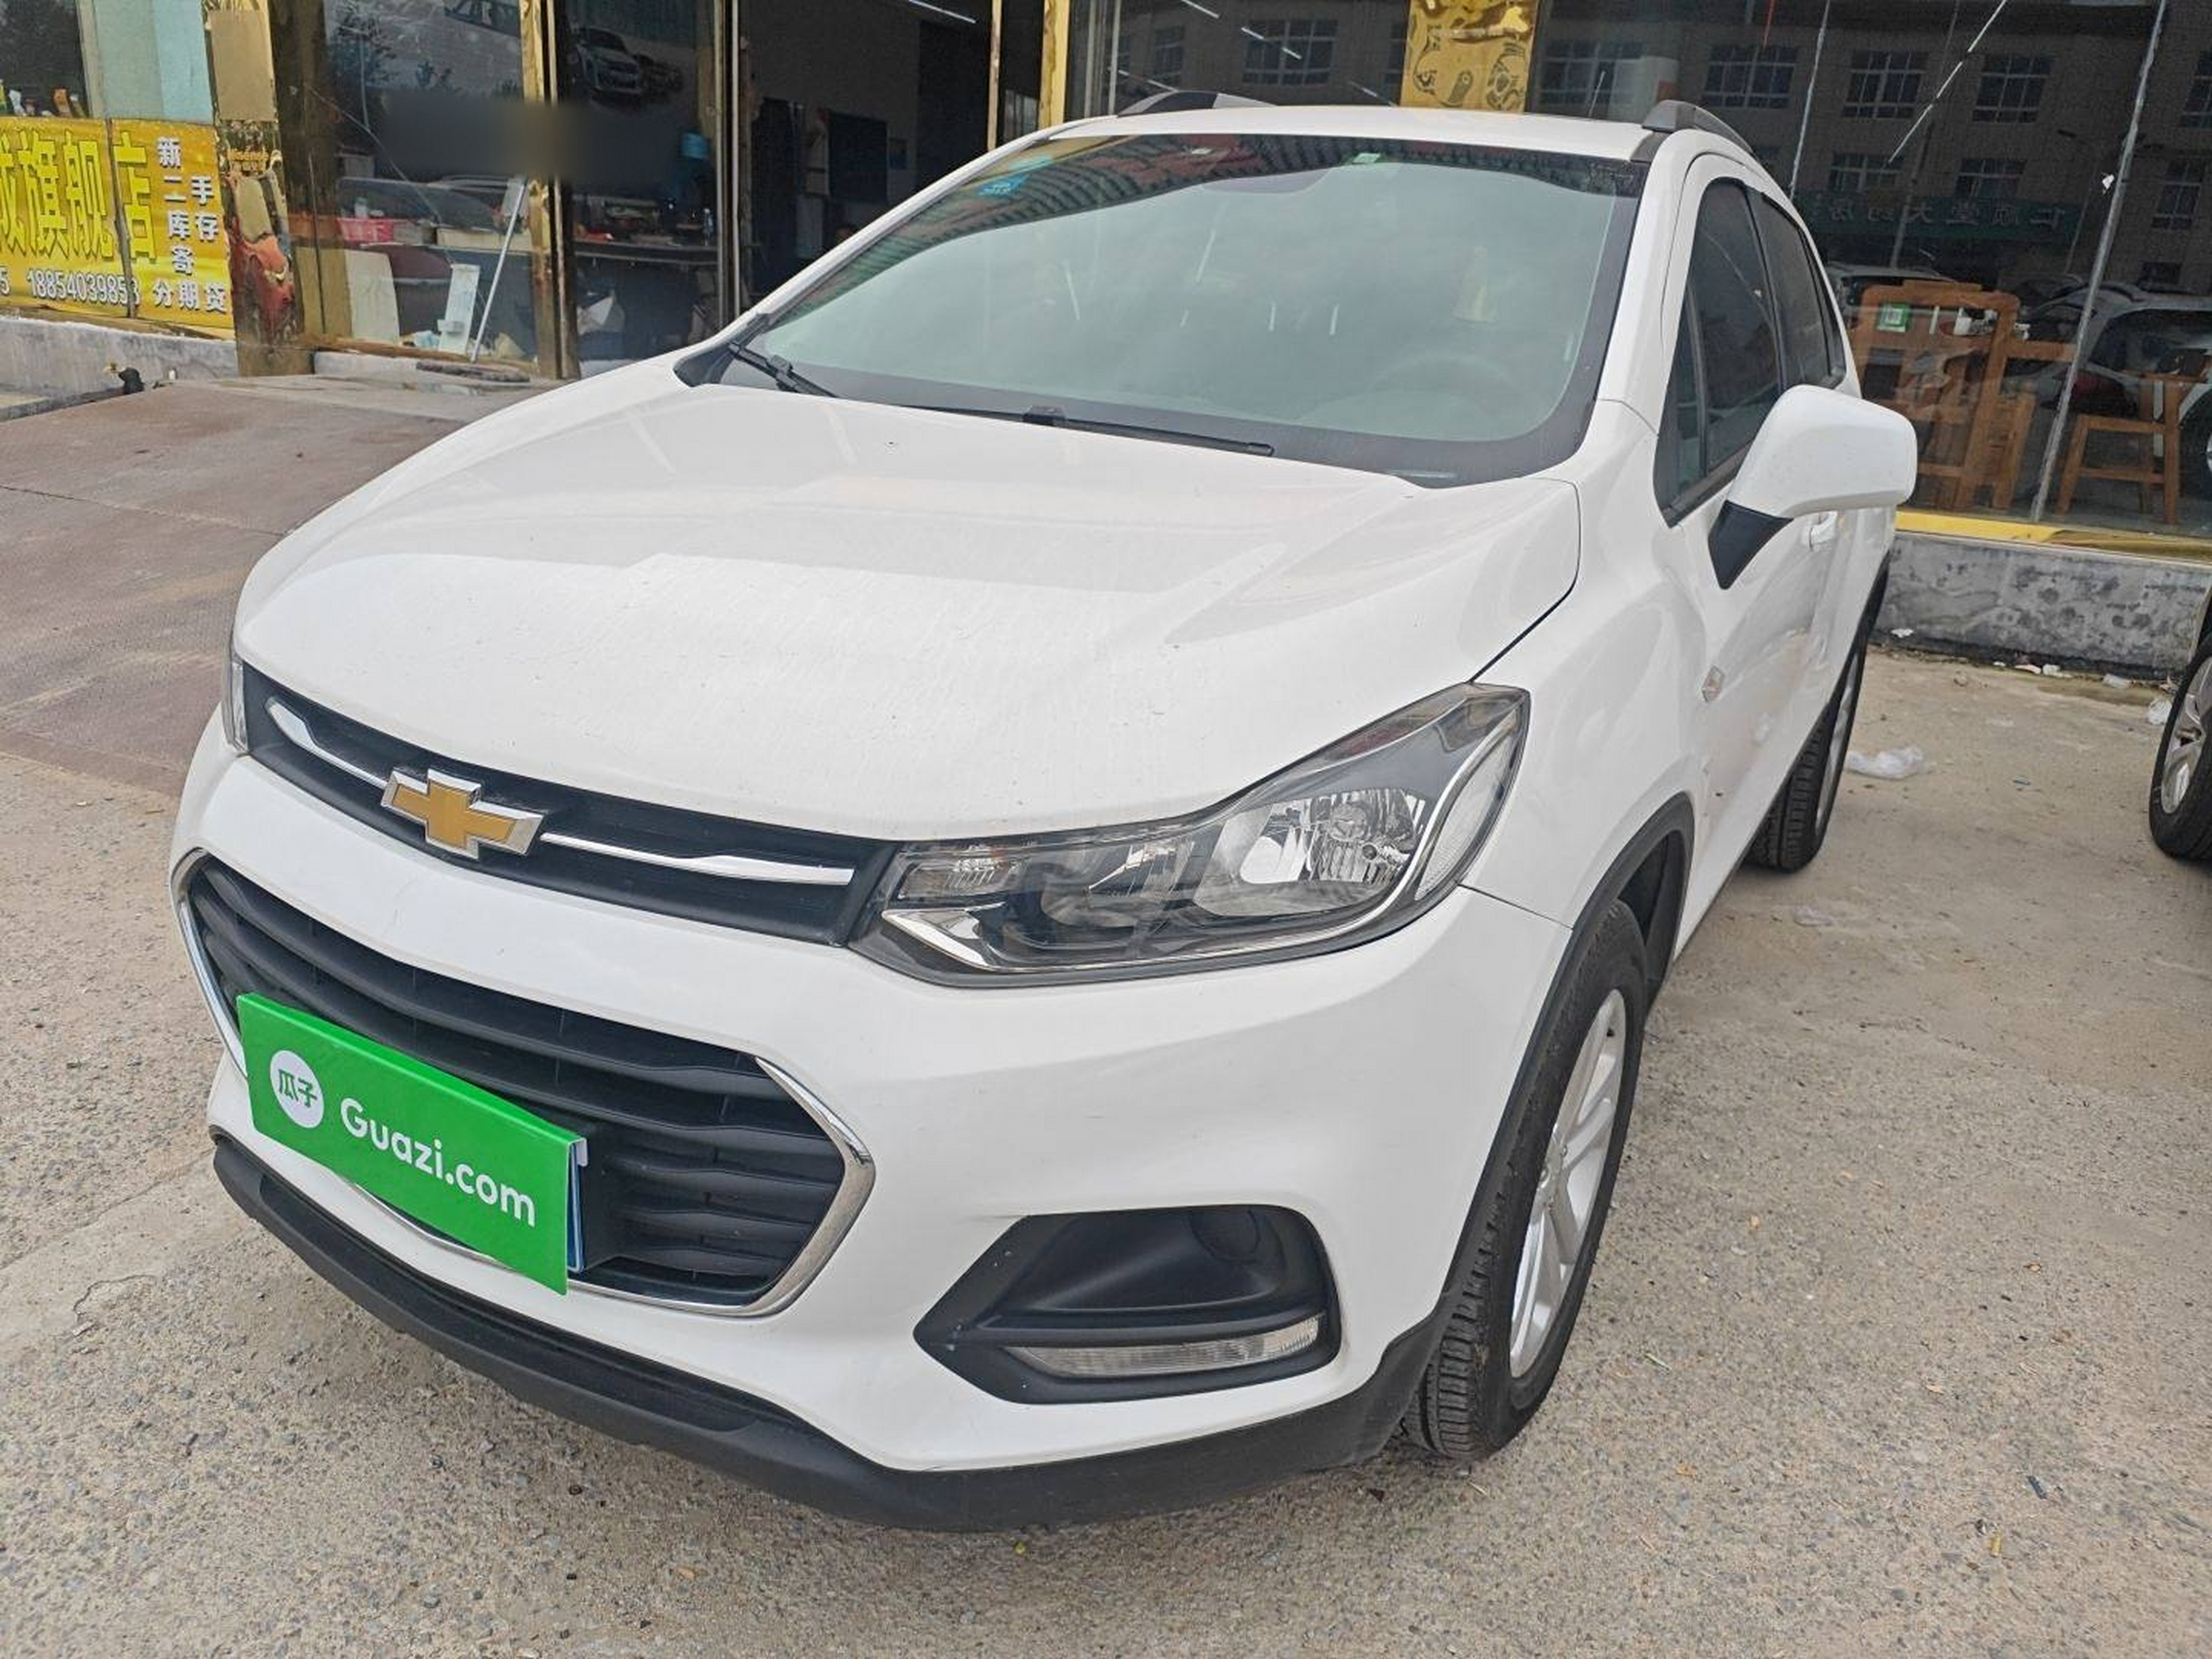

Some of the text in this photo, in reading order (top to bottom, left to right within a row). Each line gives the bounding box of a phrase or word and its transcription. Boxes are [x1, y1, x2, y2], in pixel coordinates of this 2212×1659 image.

[167, 210, 218, 241] 库存
[278, 1069, 318, 1108] 瓜子
[340, 1097, 536, 1228] Guazi.com
